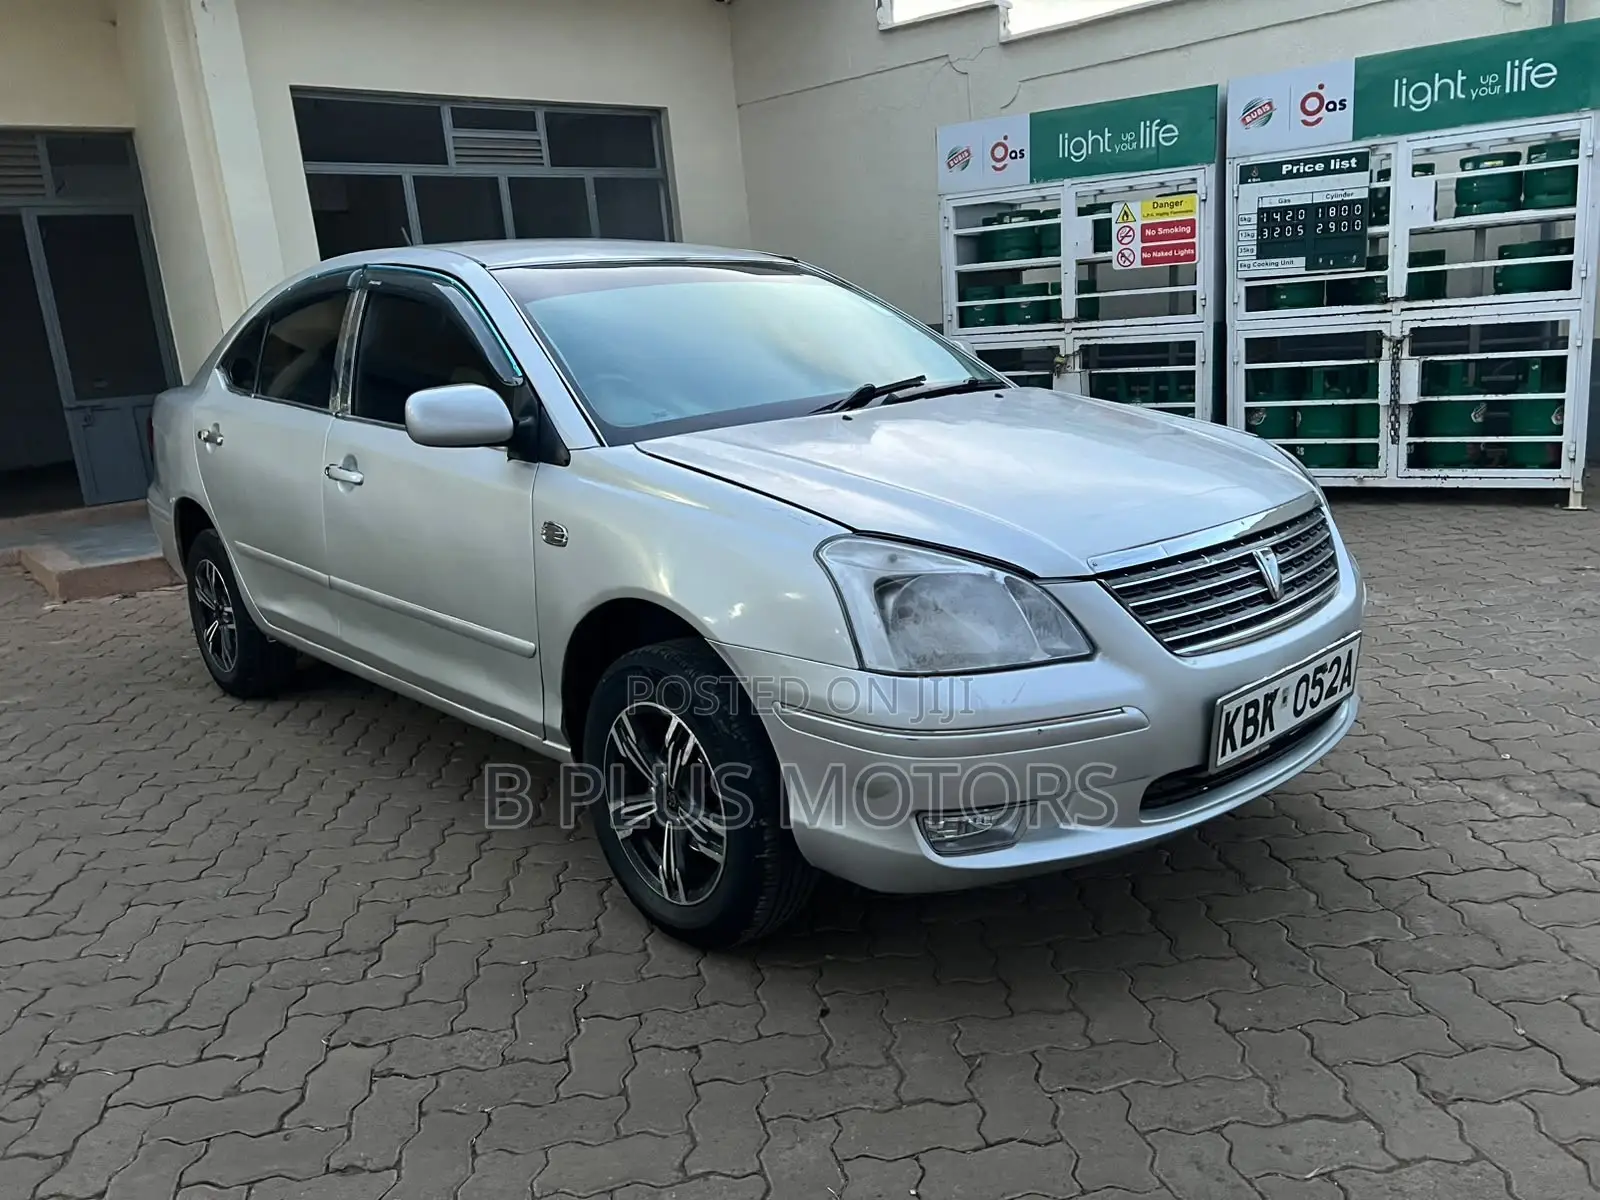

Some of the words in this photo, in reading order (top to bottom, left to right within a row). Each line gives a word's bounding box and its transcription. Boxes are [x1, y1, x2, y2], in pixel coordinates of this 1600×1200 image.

[1480, 73, 1499, 88] up
[1505, 58, 1558, 93] life
[1393, 69, 1467, 112] light
[1470, 83, 1501, 100] your
[1300, 83, 1347, 127] gas
[1121, 131, 1136, 142] up
[1139, 119, 1179, 149] life
[990, 135, 1025, 171] gas
[1059, 127, 1112, 162] light
[1114, 140, 1137, 154] your
[1281, 162, 1325, 175] Price
[1330, 157, 1358, 170] list
[1325, 191, 1354, 200] Cylinder
[1152, 200, 1184, 210] Danger
[1263, 209, 1305, 223] 1420
[1318, 204, 1362, 218] 1800
[1145, 228, 1156, 236] No
[1157, 225, 1191, 235] Smoking
[1262, 224, 1304, 239] 3205
[1316, 219, 1362, 234] 2900
[1142, 251, 1151, 259] No
[1152, 249, 1173, 257] Naked
[1174, 248, 1195, 256] Lights
[1221, 687, 1280, 758] KBK
[1293, 648, 1353, 718] 052A
